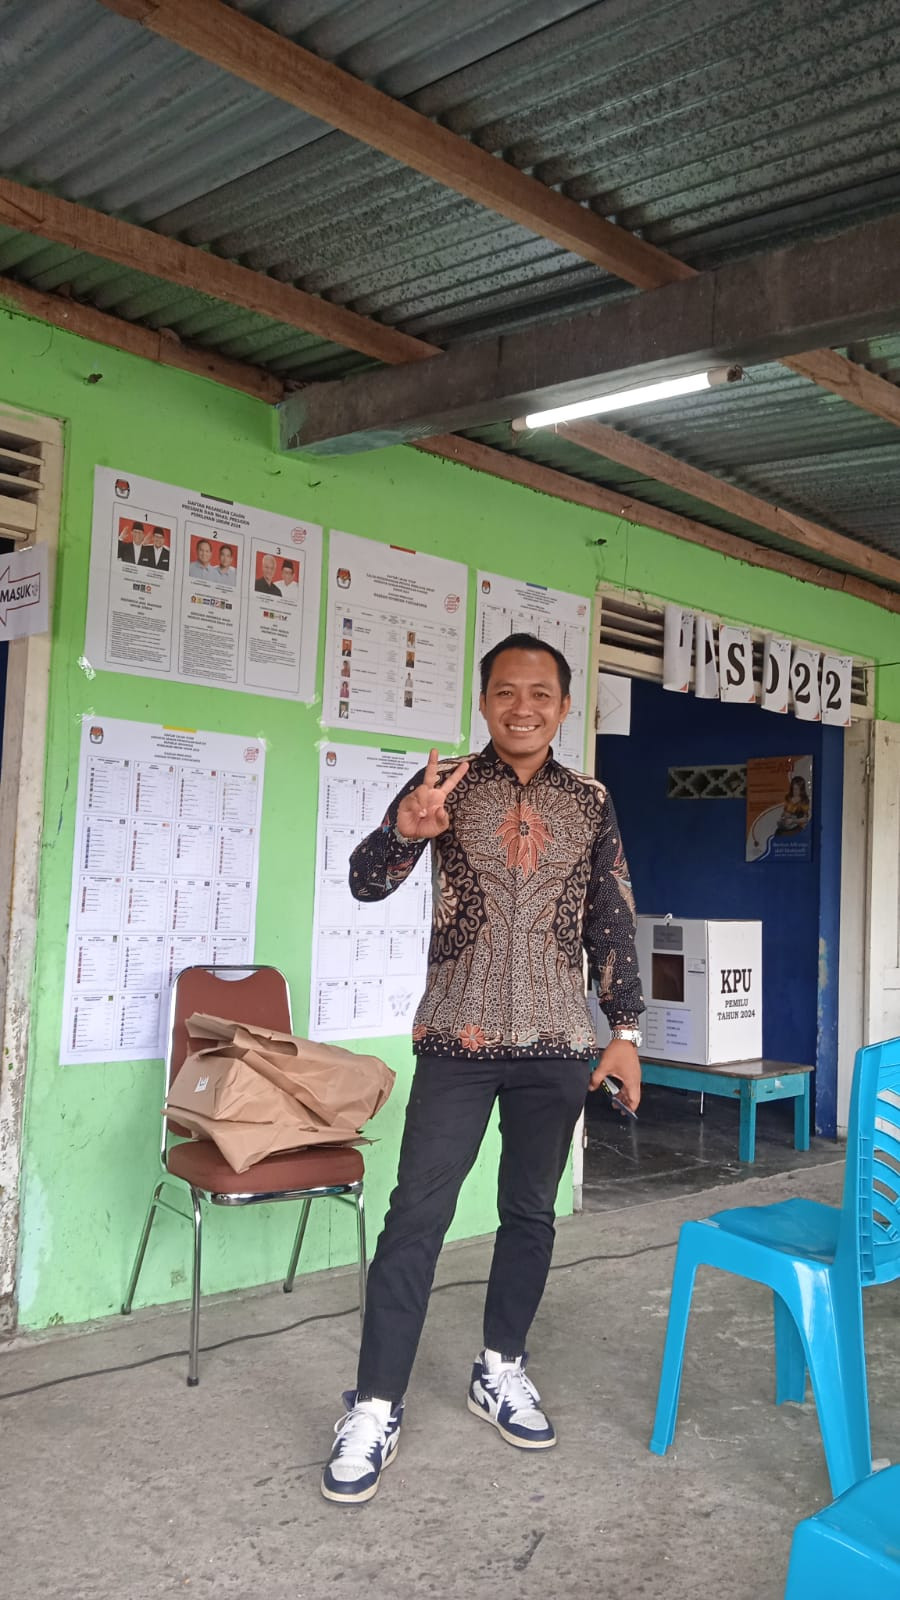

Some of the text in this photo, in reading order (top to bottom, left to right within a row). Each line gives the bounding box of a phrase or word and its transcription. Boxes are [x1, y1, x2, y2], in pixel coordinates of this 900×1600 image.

[213, 531, 218, 539] 2
[0, 584, 31, 602] MASUK
[721, 968, 752, 994] KPU
[725, 999, 749, 1008] PEMILU
[717, 1009, 756, 1021] TAHUN 2024
